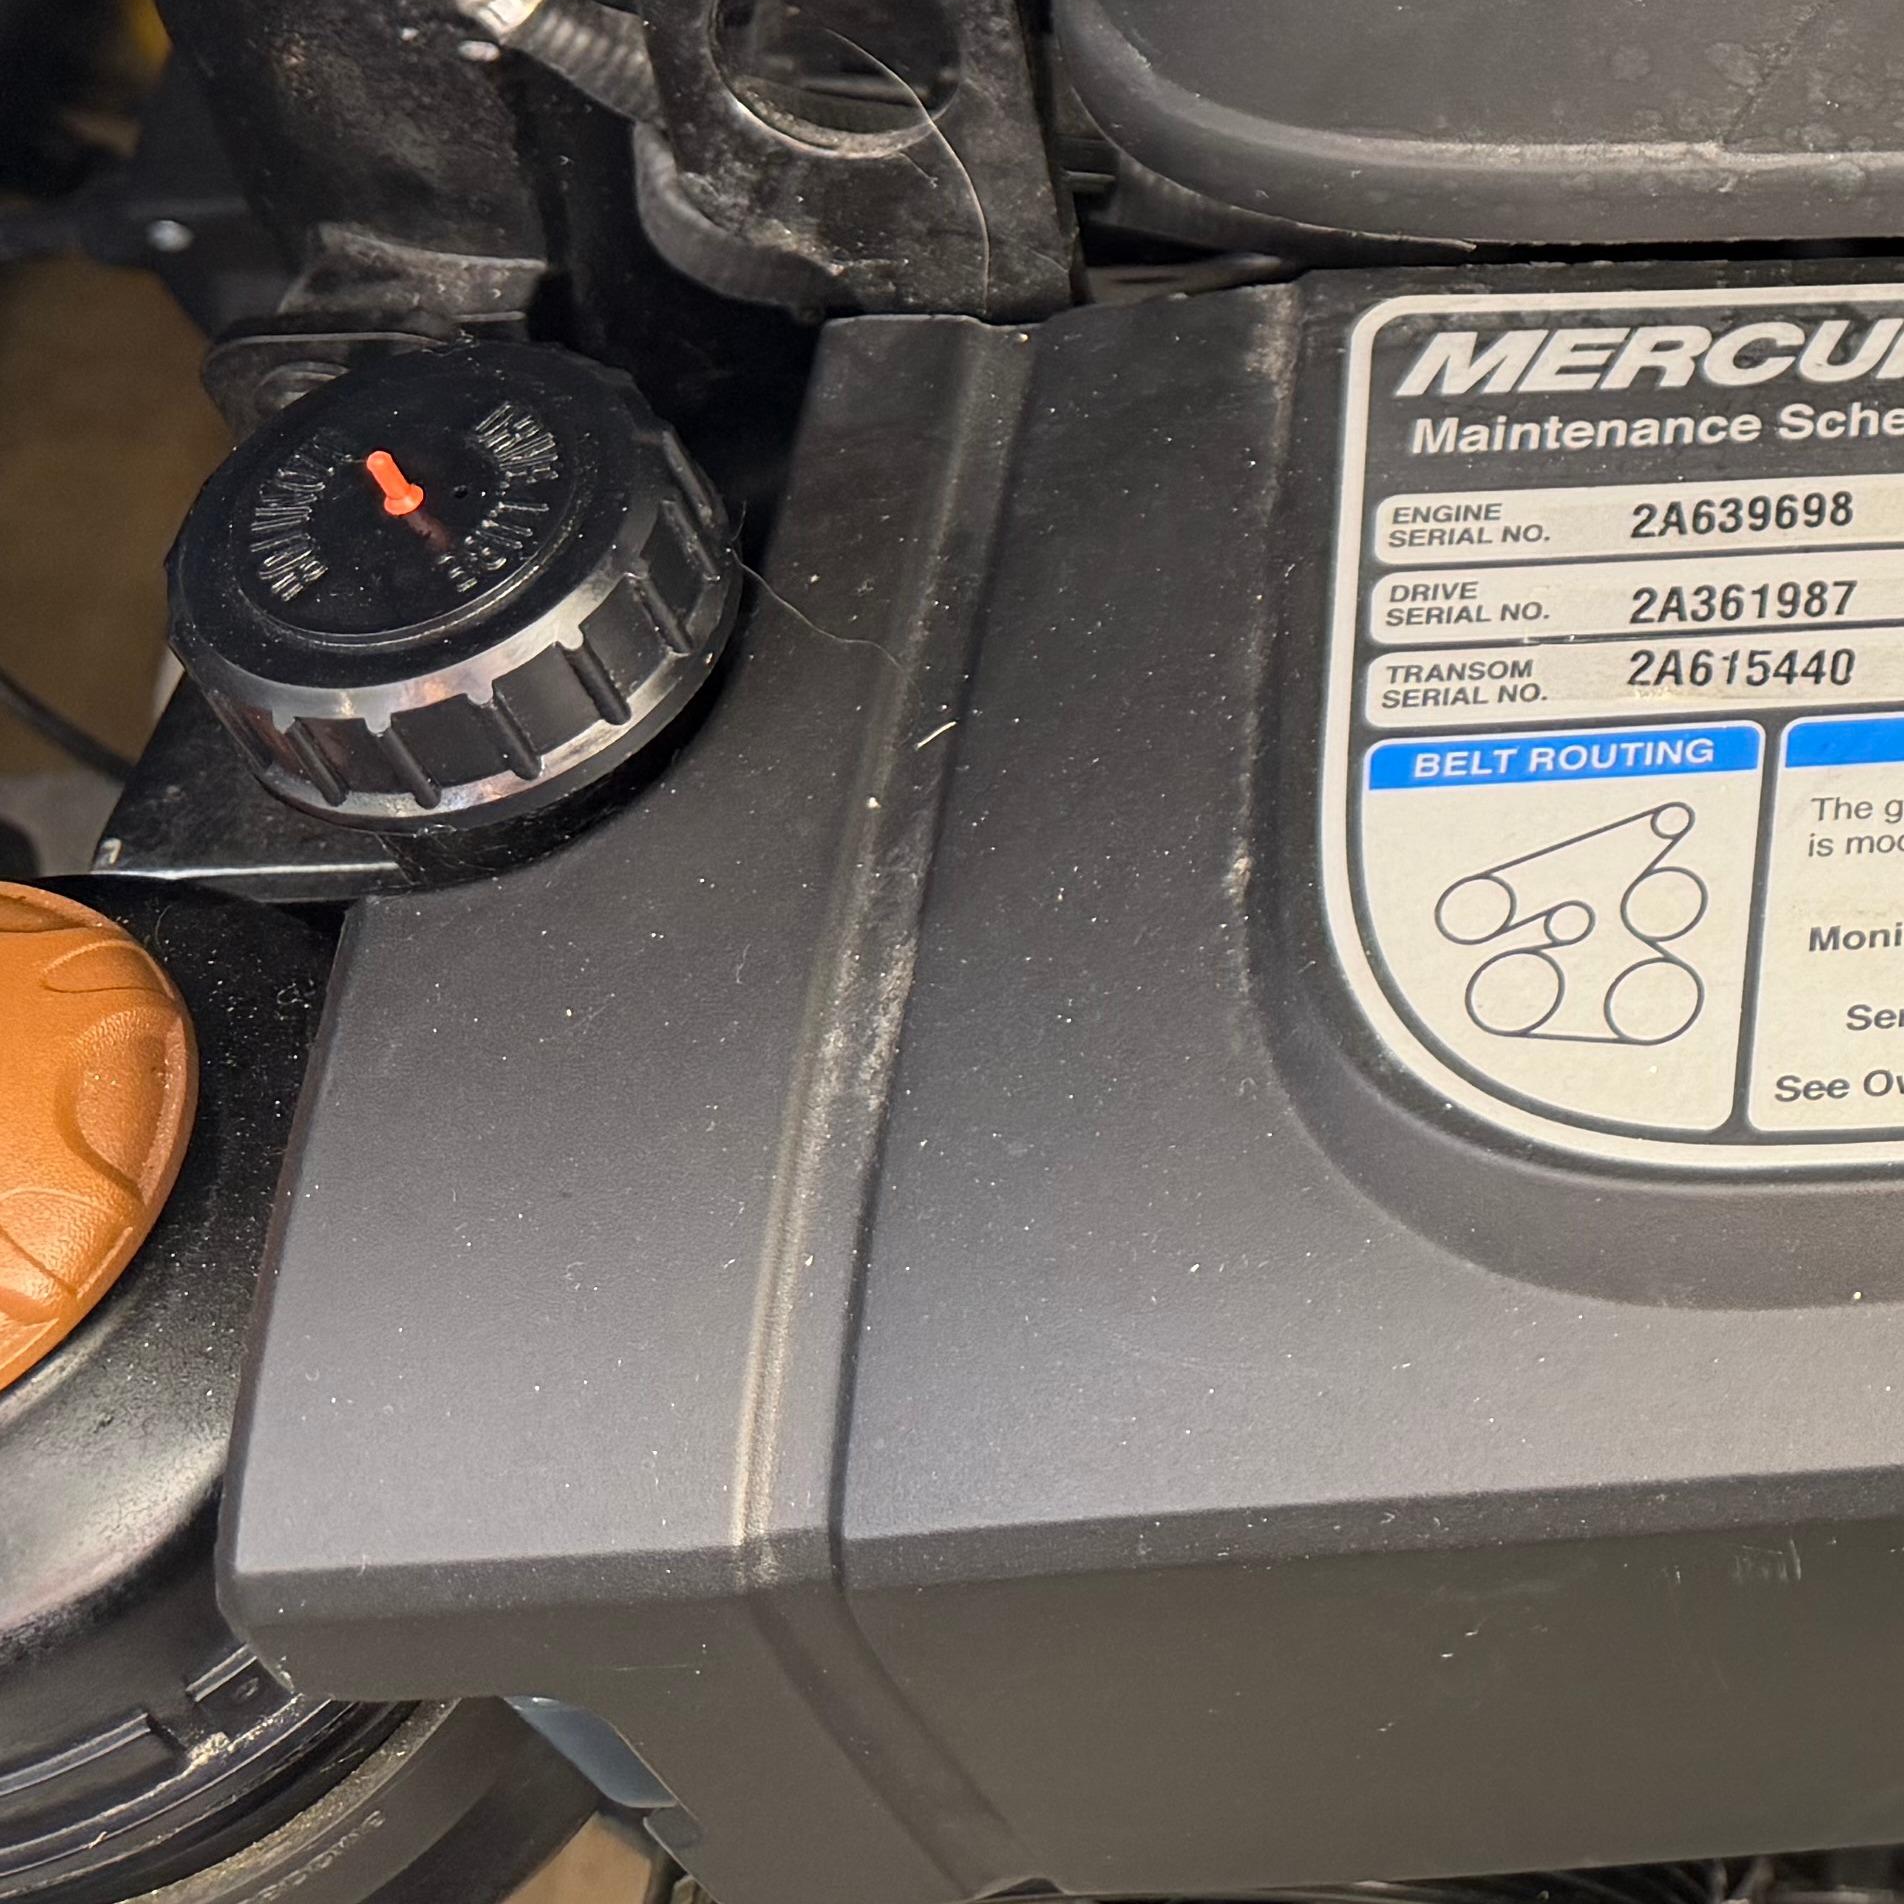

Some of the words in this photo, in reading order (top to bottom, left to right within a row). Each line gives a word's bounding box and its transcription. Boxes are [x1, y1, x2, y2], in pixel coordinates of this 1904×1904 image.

[1411, 413, 1763, 455] Maintenance
[1391, 501, 1503, 526] ENGINE
[1629, 490, 1854, 540] 2A639698
[1387, 525, 1494, 549] SERIAL
[1500, 523, 1551, 544] NO.
[1388, 580, 1480, 604] DRIVE
[1628, 579, 1858, 625] 2A361987
[1384, 603, 1492, 628] SERIAL
[1499, 600, 1551, 623] NO.
[1385, 658, 1534, 685] TRANSOM
[1625, 647, 1856, 688] 2A615440
[1380, 685, 1490, 710] SERIAL
[1496, 681, 1549, 705] NO.
[1413, 747, 1519, 779] BELT
[1527, 737, 1715, 774] ROUTING
[1810, 795, 1874, 823] The
[1807, 831, 1835, 858] is
[1774, 1073, 1851, 1104] See
